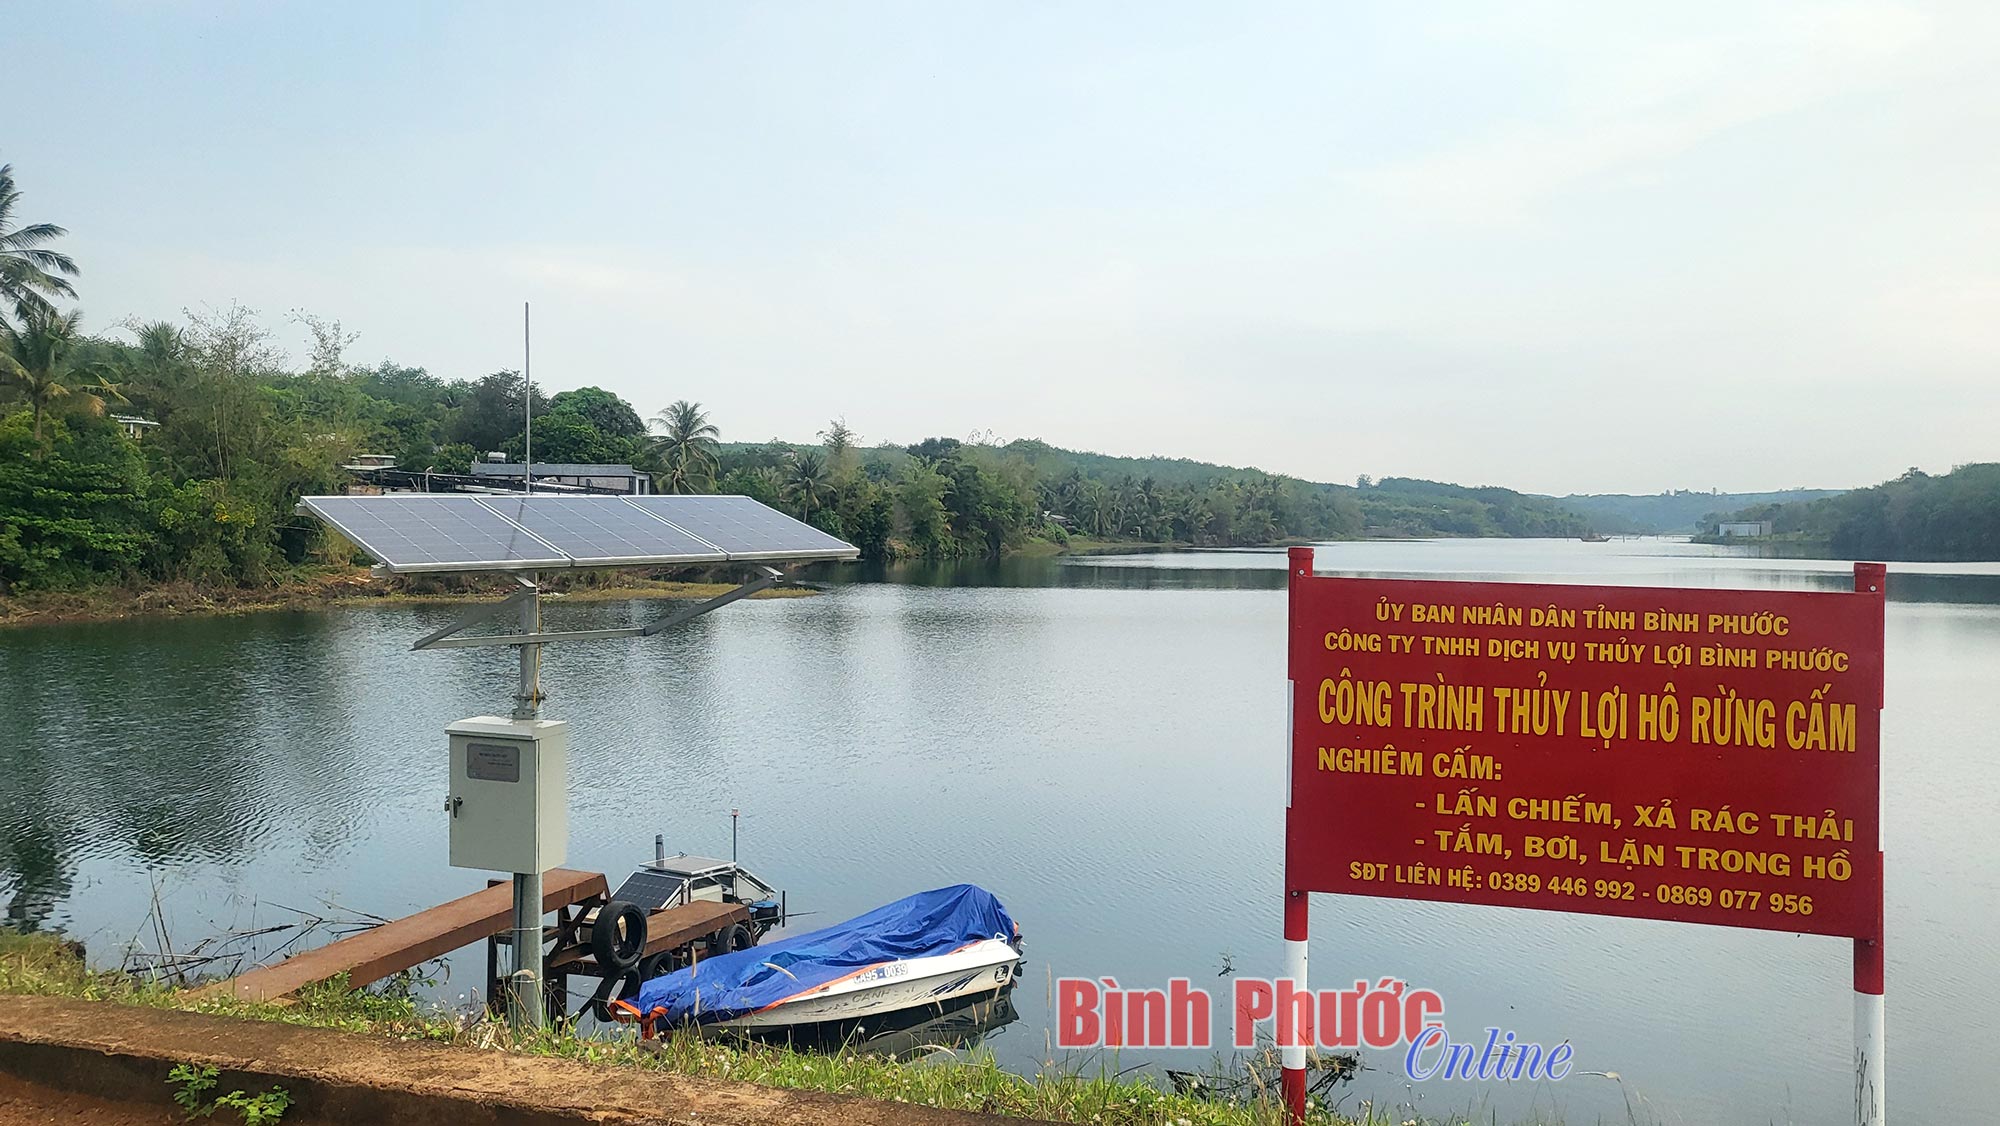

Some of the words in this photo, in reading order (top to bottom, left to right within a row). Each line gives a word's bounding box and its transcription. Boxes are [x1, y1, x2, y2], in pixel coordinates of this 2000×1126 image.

[1376, 596, 1404, 621] ỦY
[1411, 604, 1455, 624] BAN
[1462, 602, 1523, 626] NHÂN
[1530, 604, 1576, 628] DÂN
[1583, 604, 1635, 630] TỈNH
[1644, 608, 1699, 632] BÌNH
[1708, 611, 1789, 636] PHƯỚC
[1325, 628, 1381, 652] CÔNG
[1388, 635, 1415, 654] TY
[1422, 636, 1480, 657] TNHH
[1488, 639, 1539, 662] DỊCH
[1547, 641, 1576, 664] VỤ
[1584, 637, 1646, 663] THỦY
[1653, 645, 1692, 669] LỢI
[1700, 643, 1757, 668] BÌNH
[1766, 646, 1849, 672] PHƯỚC
[1318, 667, 1392, 728] CÔNG
[1400, 672, 1484, 732] TRÌNH
[1493, 670, 1571, 736] THỦY
[1580, 685, 1628, 749] LỢI
[1639, 682, 1680, 743] HÔ
[1691, 684, 1776, 749] RỪNG
[1785, 683, 1856, 752] CẤM
[1318, 744, 1423, 776] NGHIÊM
[1432, 745, 1502, 781] CẤM:
[1436, 787, 1497, 818] LẤN
[1507, 793, 1622, 829] CHIẾM,
[1633, 799, 1676, 829] XẢ
[1690, 805, 1759, 834] RÁC
[1770, 809, 1854, 842] THẢI
[1434, 823, 1512, 860] TẮM,
[1524, 835, 1588, 865] BƠI,
[1600, 838, 1664, 870] LẶN
[1675, 846, 1791, 877] TRONG
[1803, 849, 1852, 881] HỒ
[1349, 861, 1388, 882] SĐT
[1395, 861, 1441, 886] LIÊN
[1448, 865, 1482, 892] HỆ:
[1488, 871, 1541, 893] 0389
[1547, 876, 1588, 897] 446
[1594, 879, 1635, 900] 992
[1656, 884, 1713, 907] 0869
[1719, 889, 1761, 910] 077
[1769, 893, 1813, 915] 956
